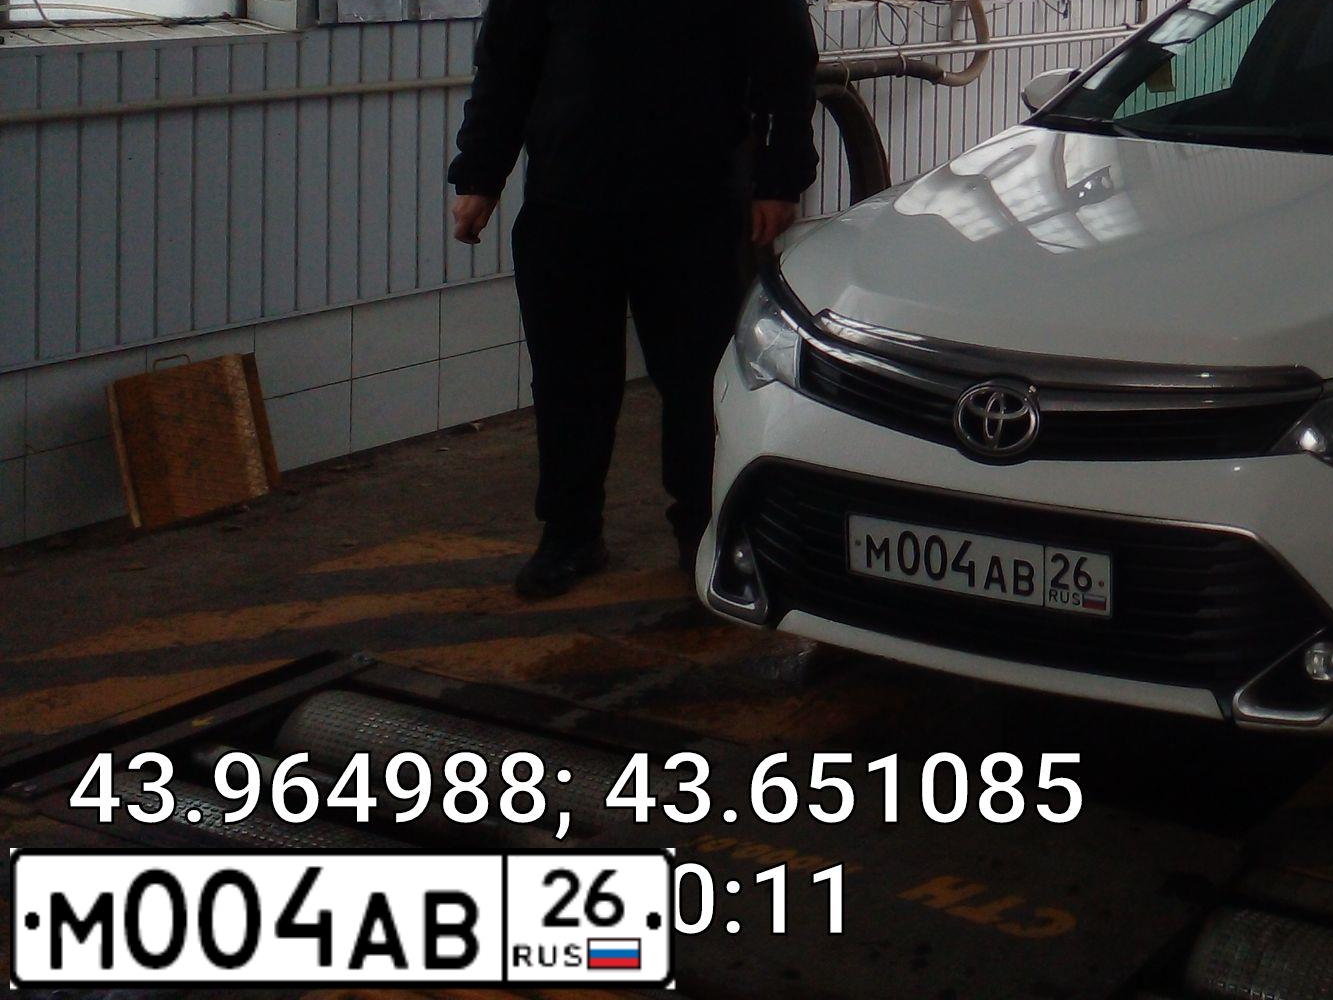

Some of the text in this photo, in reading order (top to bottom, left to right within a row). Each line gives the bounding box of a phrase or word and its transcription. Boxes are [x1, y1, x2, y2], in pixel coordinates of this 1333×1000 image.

[865, 530, 1094, 597] М004АВ 26
[1047, 588, 1082, 606] RUS
